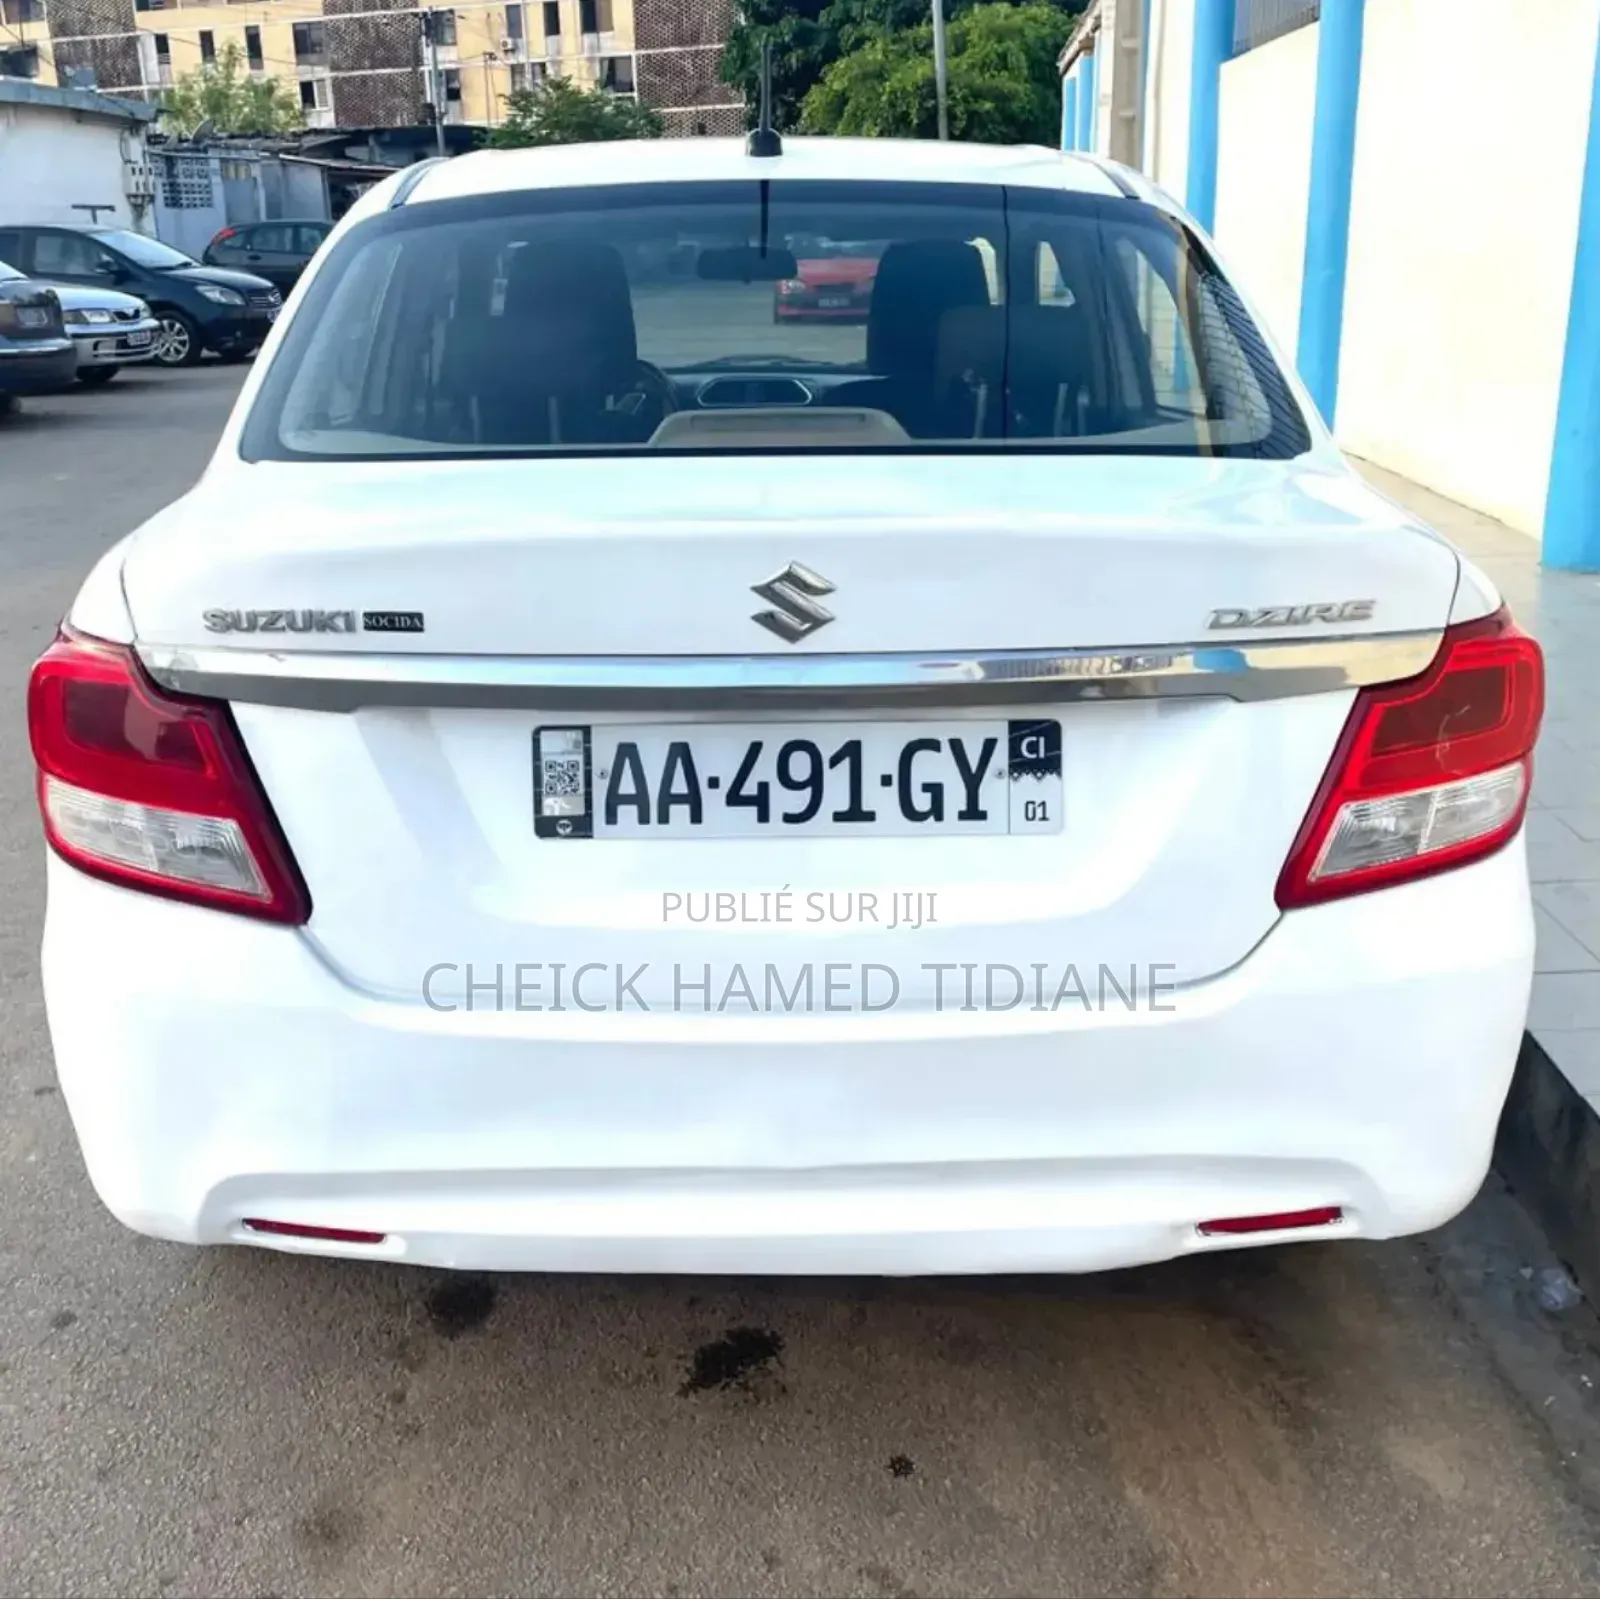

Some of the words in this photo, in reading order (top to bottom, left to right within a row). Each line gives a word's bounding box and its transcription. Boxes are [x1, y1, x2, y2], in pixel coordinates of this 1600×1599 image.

[203, 608, 357, 633] SUZUKI
[364, 614, 423, 630] SOCIDA
[1206, 599, 1377, 629] DZIRE
[1020, 736, 1045, 758] CI
[1024, 800, 1050, 821] 01
